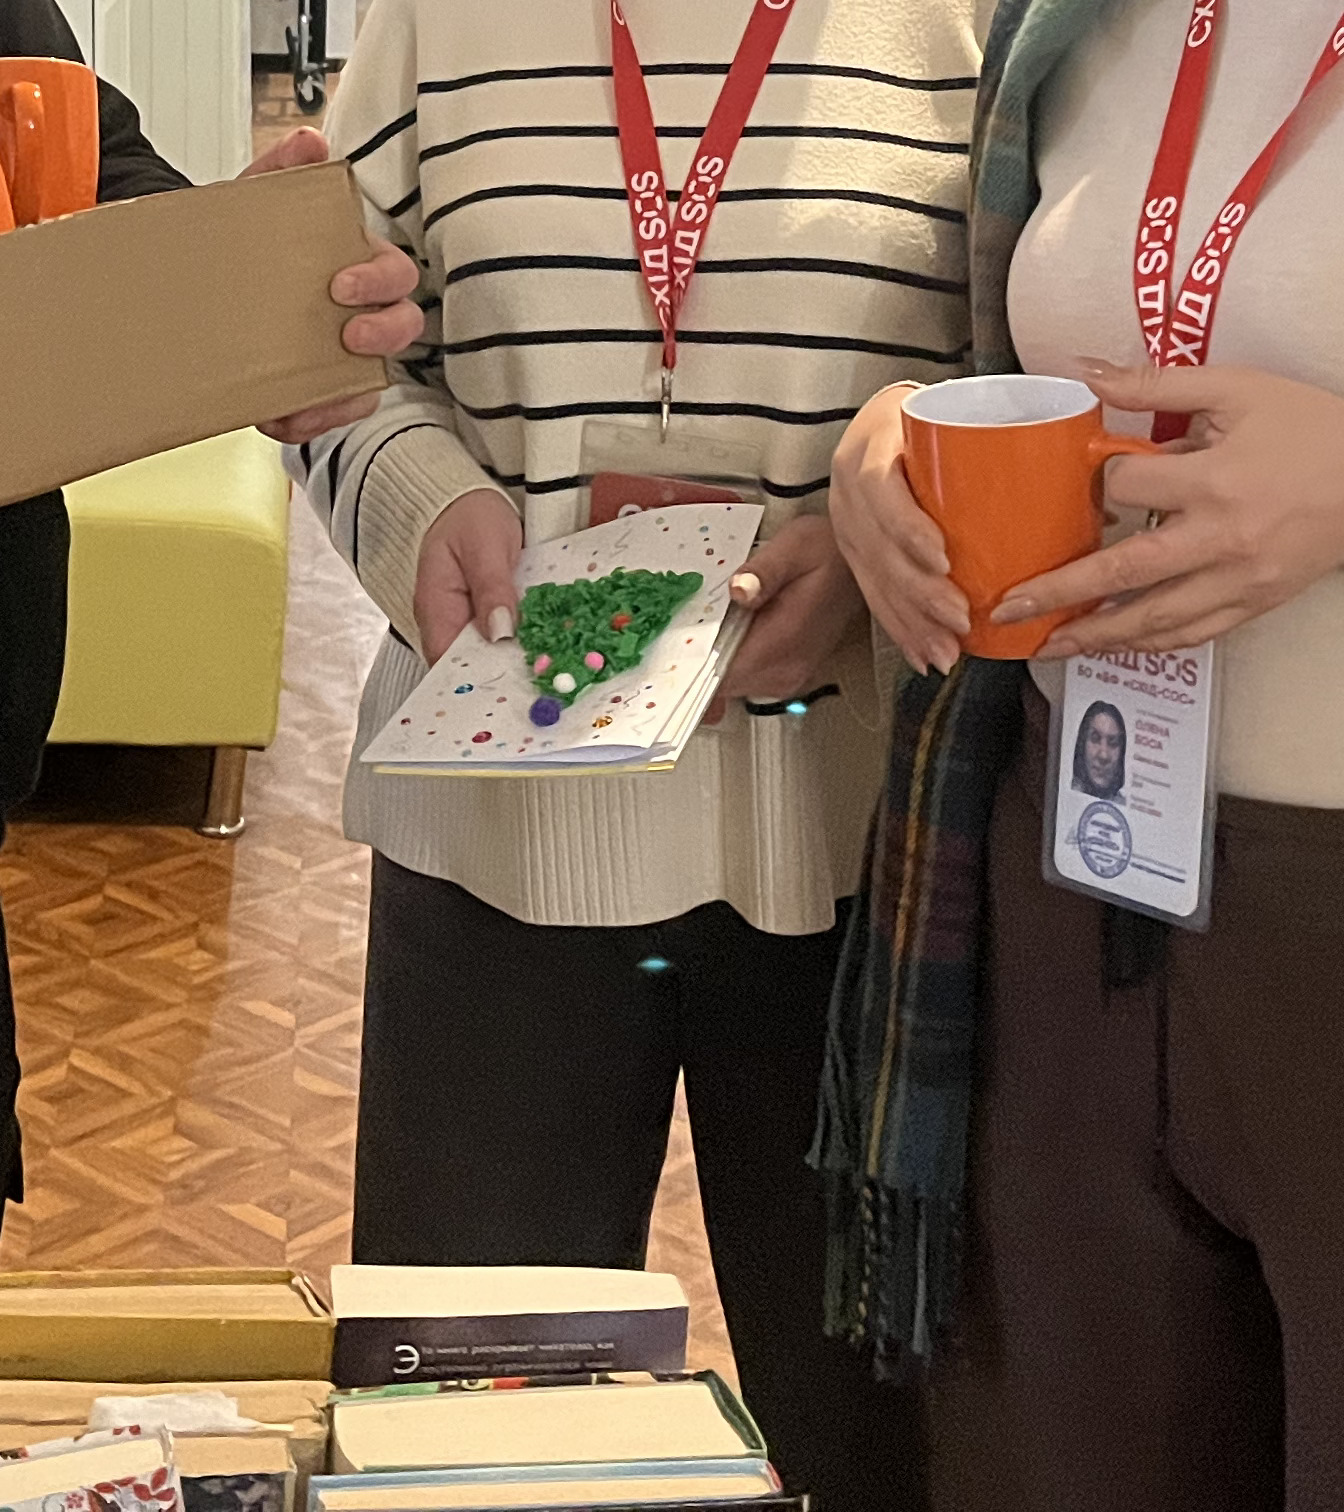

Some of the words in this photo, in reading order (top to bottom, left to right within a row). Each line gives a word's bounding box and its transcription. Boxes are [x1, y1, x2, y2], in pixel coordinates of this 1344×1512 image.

[631, 170, 667, 241] SOS
[681, 155, 724, 224] SOS
[1137, 196, 1177, 276] SOS
[1138, 279, 1166, 368] ХІД
[1166, 290, 1213, 367] ХІД
[1191, 201, 1246, 285] SOS
